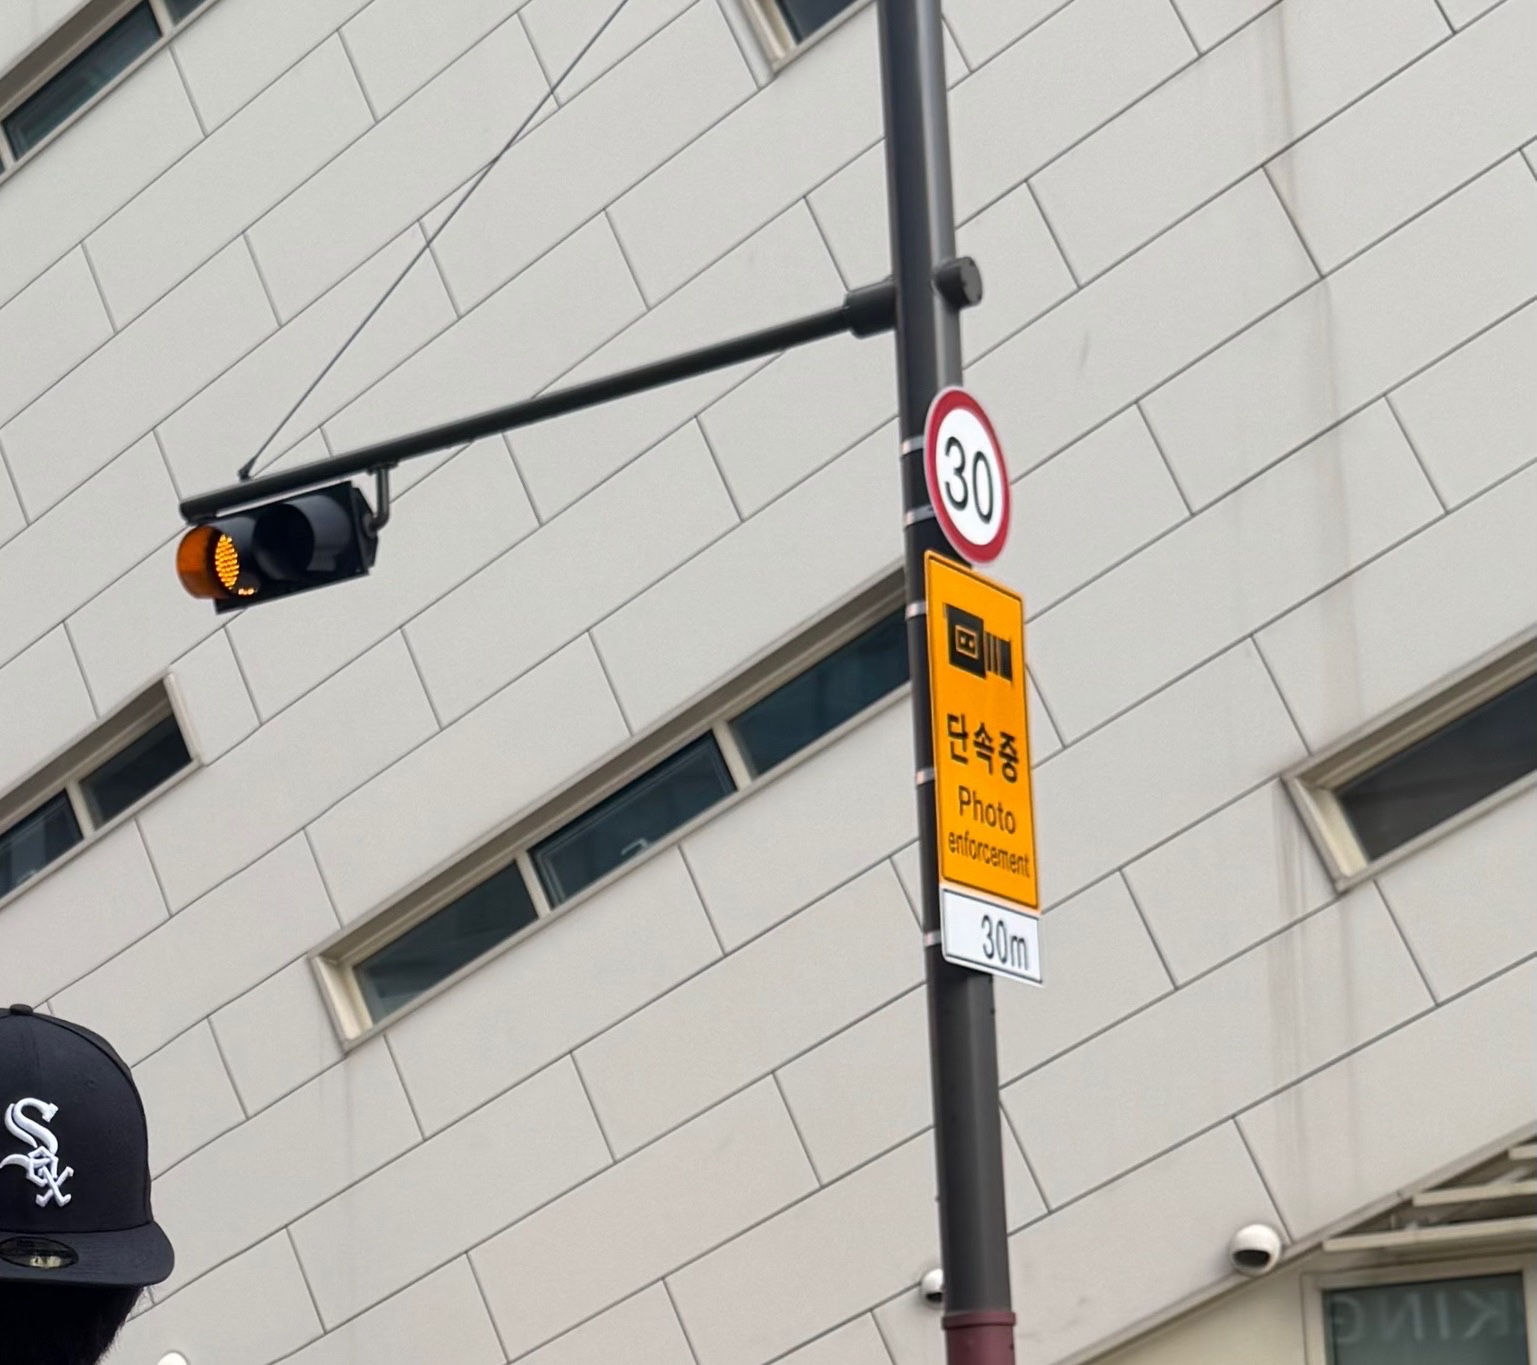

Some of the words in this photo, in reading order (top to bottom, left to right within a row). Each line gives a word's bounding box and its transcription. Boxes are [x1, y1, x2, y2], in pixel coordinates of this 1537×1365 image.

[944, 436, 994, 525] 30
[946, 712, 1020, 784] 단속중
[958, 785, 1017, 835] Photo
[948, 829, 1031, 878] enforcement
[981, 914, 1030, 971] 30m
